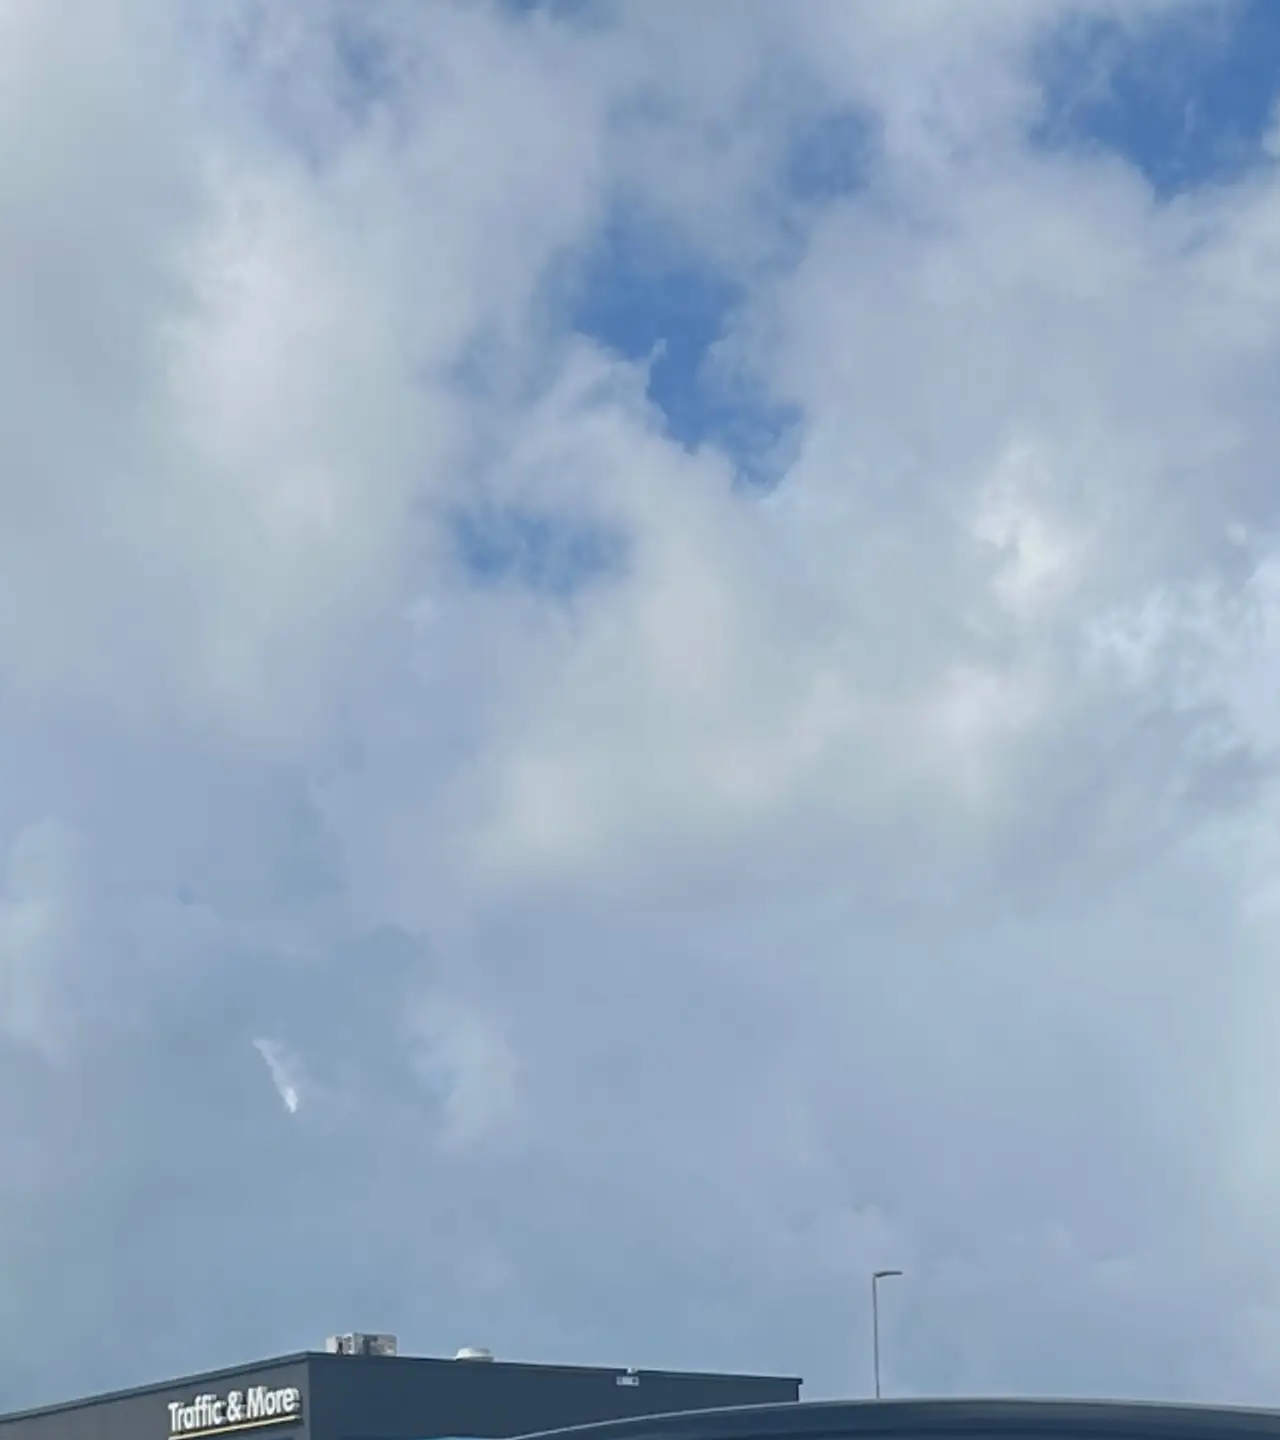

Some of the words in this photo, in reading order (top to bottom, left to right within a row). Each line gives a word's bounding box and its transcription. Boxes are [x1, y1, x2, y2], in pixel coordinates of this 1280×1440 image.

[168, 1393, 226, 1432] Traffic
[227, 1390, 243, 1422] &
[247, 1385, 300, 1418] More
